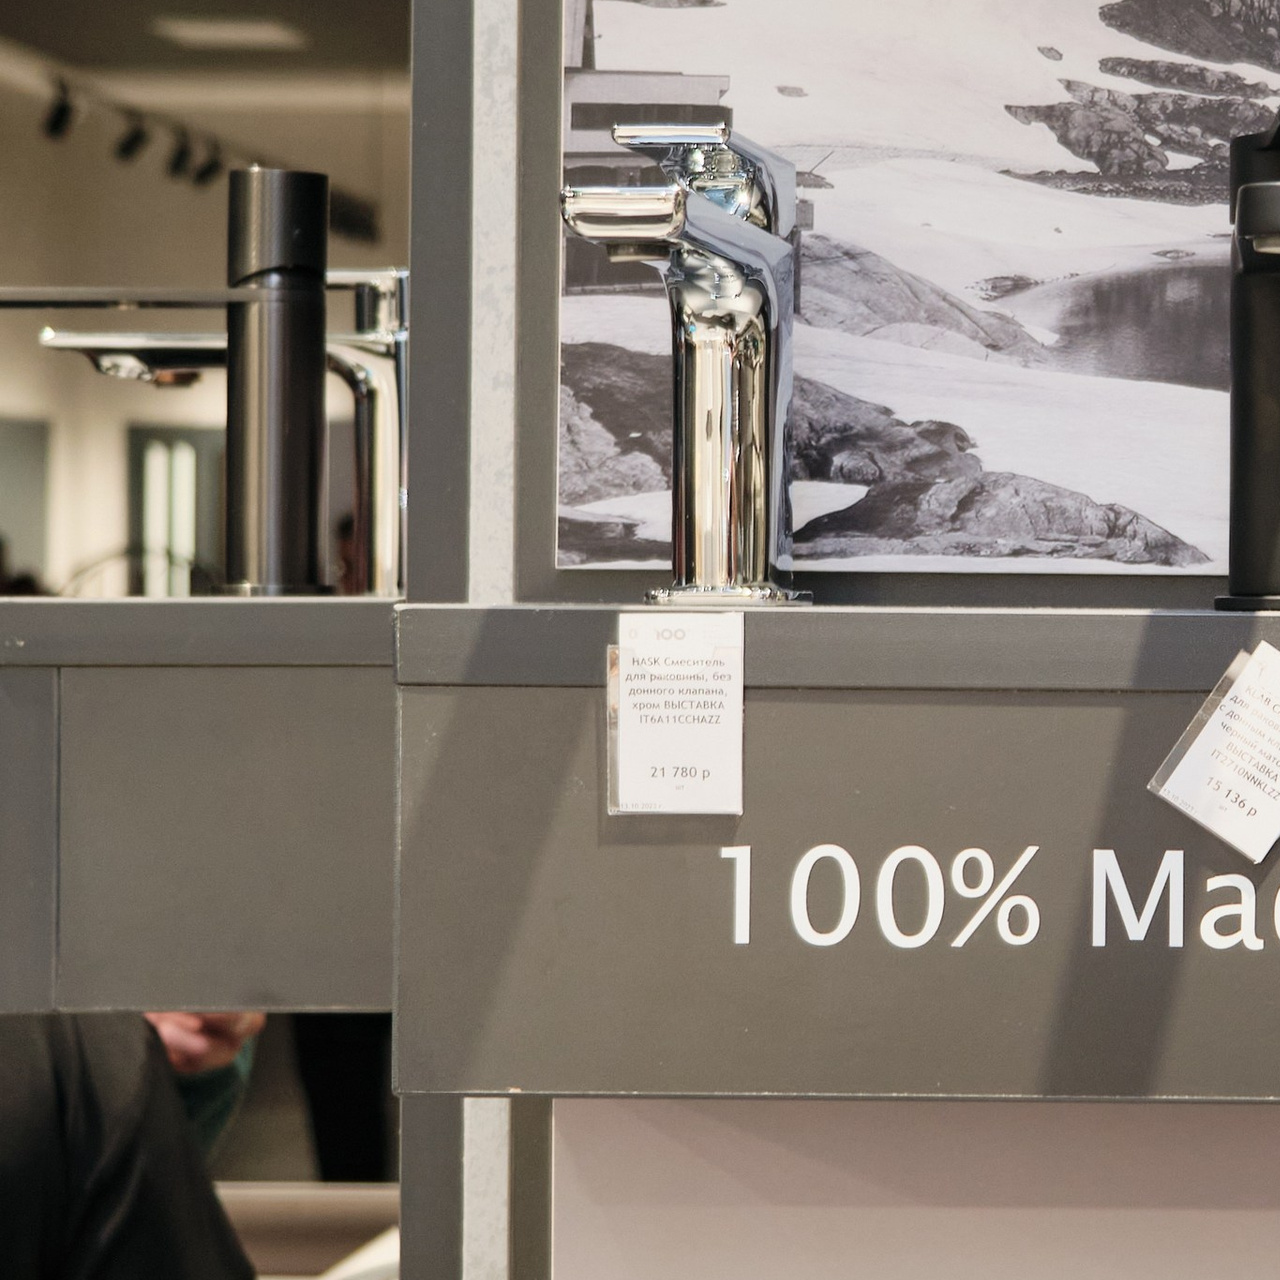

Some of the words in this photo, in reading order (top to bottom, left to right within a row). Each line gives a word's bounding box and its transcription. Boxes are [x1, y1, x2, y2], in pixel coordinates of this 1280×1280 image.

[632, 657, 660, 667] HASK
[664, 657, 725, 667] Смеситель
[625, 673, 646, 683] для
[650, 674, 708, 682] раковины,
[713, 672, 732, 681] без
[628, 688, 675, 696] донного
[678, 688, 727, 697] клапана,
[632, 702, 660, 711] хром
[664, 701, 724, 710] ВЫСТАВКА
[650, 767, 665, 778] 21
[673, 767, 697, 778] 780
[720, 844, 1040, 950] 100%
